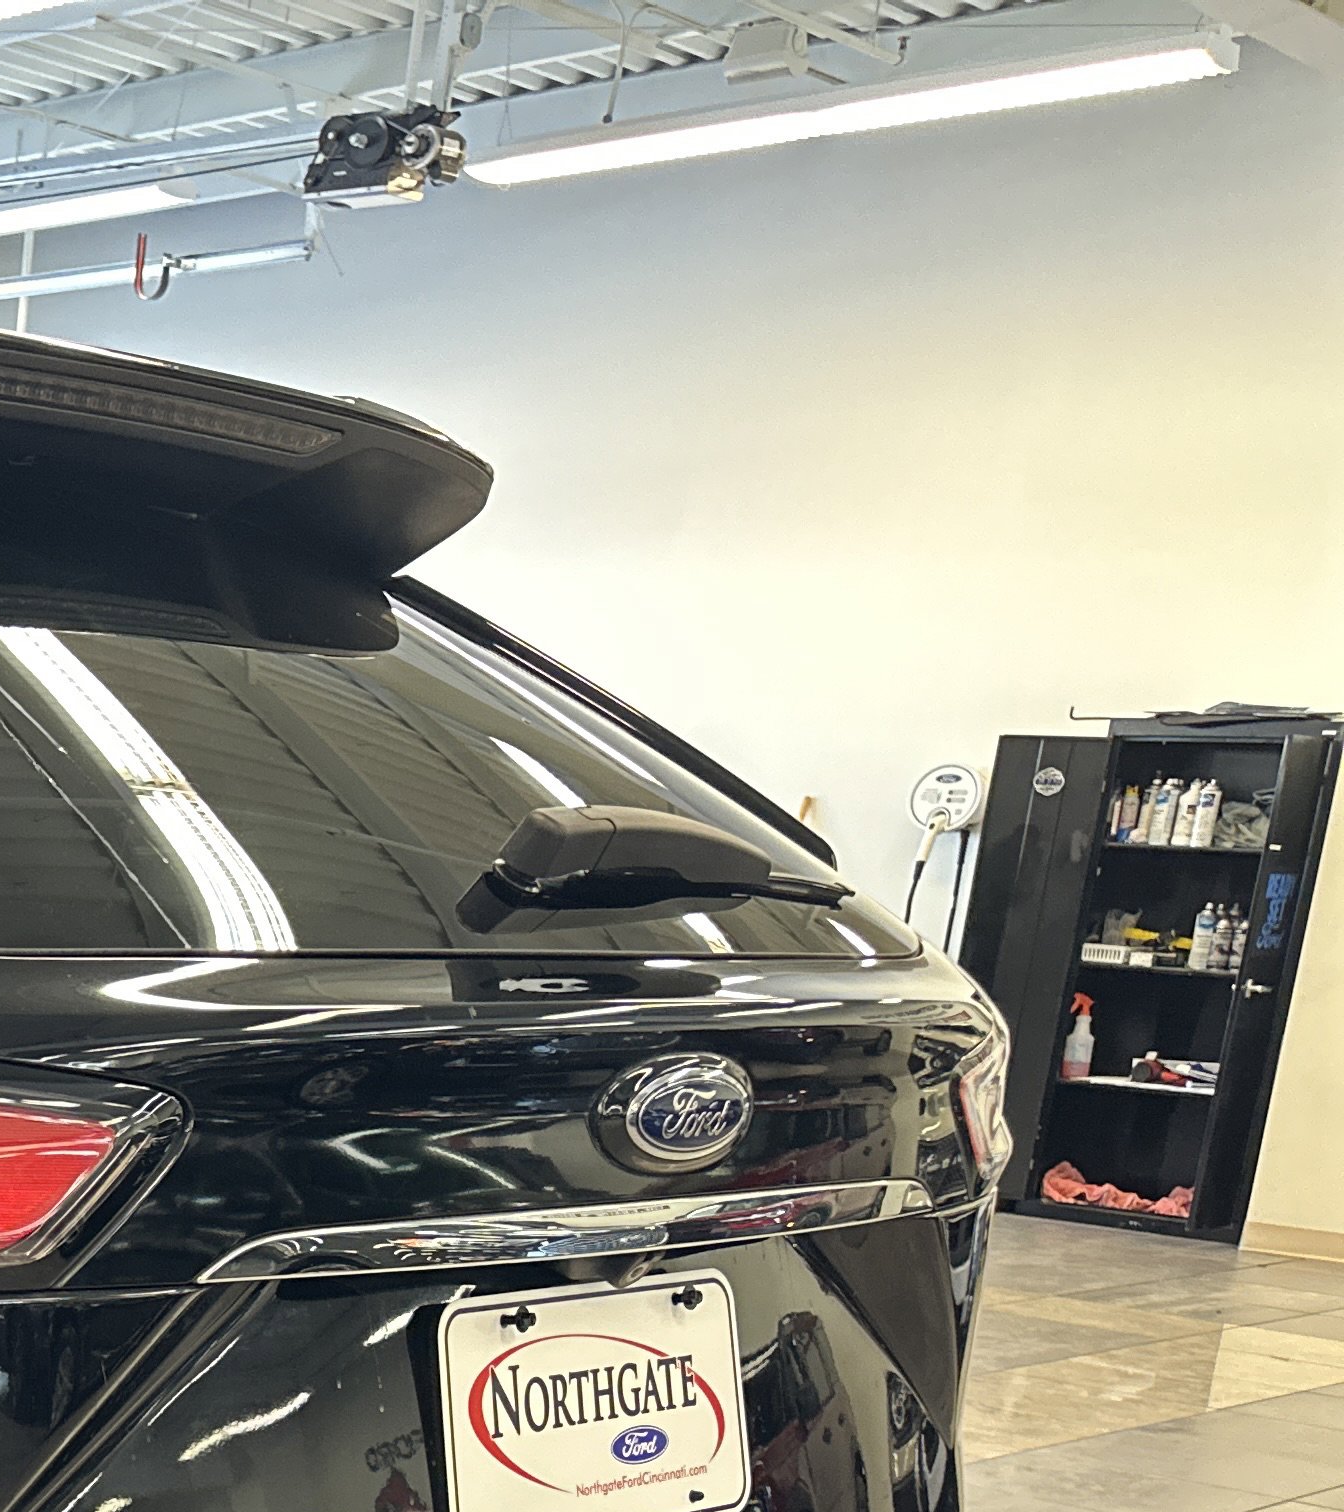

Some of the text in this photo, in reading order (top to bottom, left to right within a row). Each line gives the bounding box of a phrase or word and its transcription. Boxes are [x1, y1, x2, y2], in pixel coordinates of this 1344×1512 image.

[662, 1087, 731, 1140] Ford
[621, 1431, 658, 1457] Ford
[575, 1464, 708, 1498] NorthgateFordCincinnati.com
